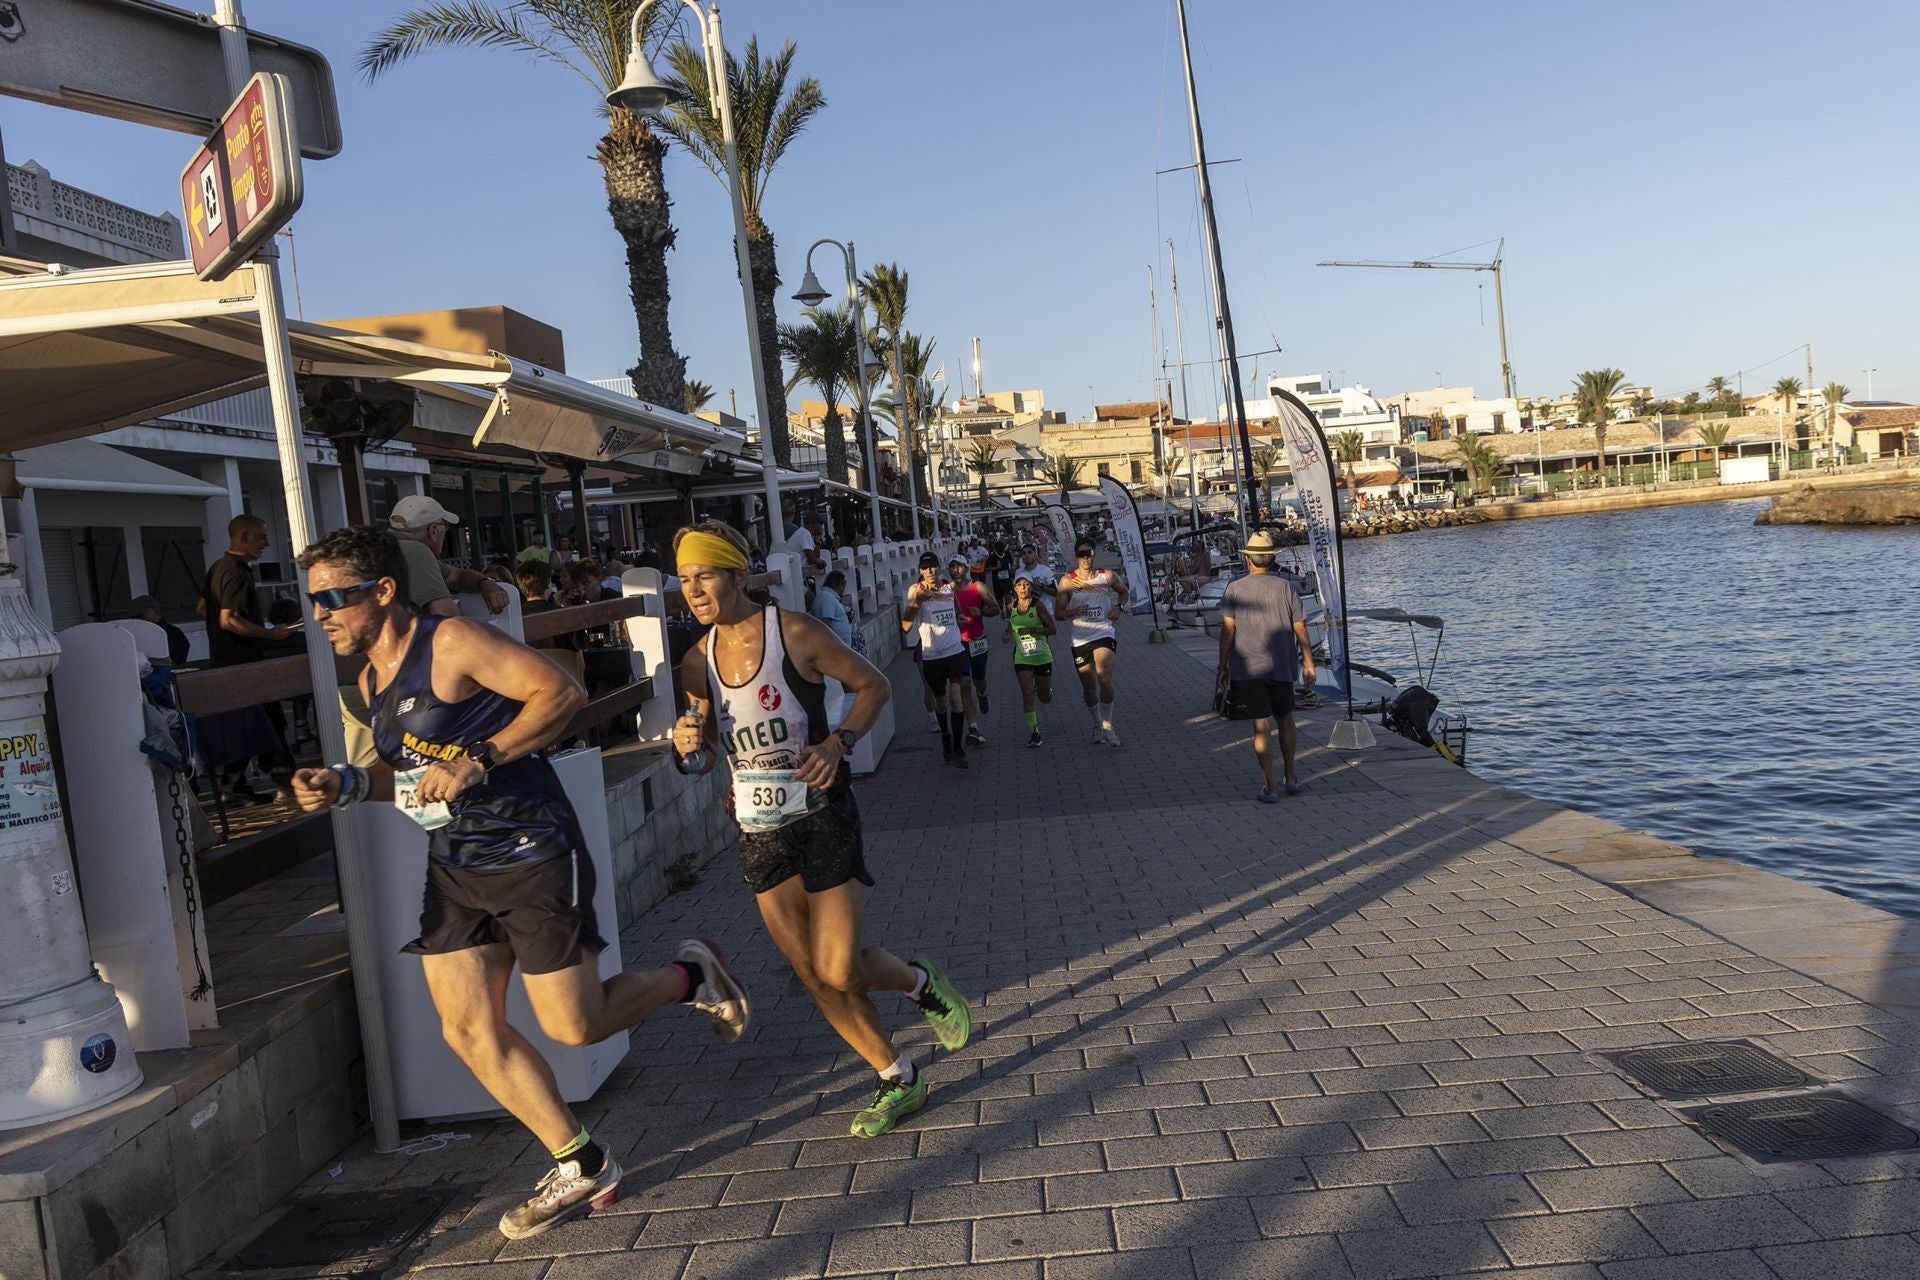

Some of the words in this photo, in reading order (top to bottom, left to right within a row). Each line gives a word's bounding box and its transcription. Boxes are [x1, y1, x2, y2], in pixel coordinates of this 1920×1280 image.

[226, 123, 250, 165] Punto
[231, 163, 255, 206] limpio
[935, 612, 953, 621] 1349
[402, 731, 468, 762] MARAT
[721, 717, 789, 755] UNED
[753, 787, 787, 807] 530
[9, 814, 49, 828] NAUTICO
